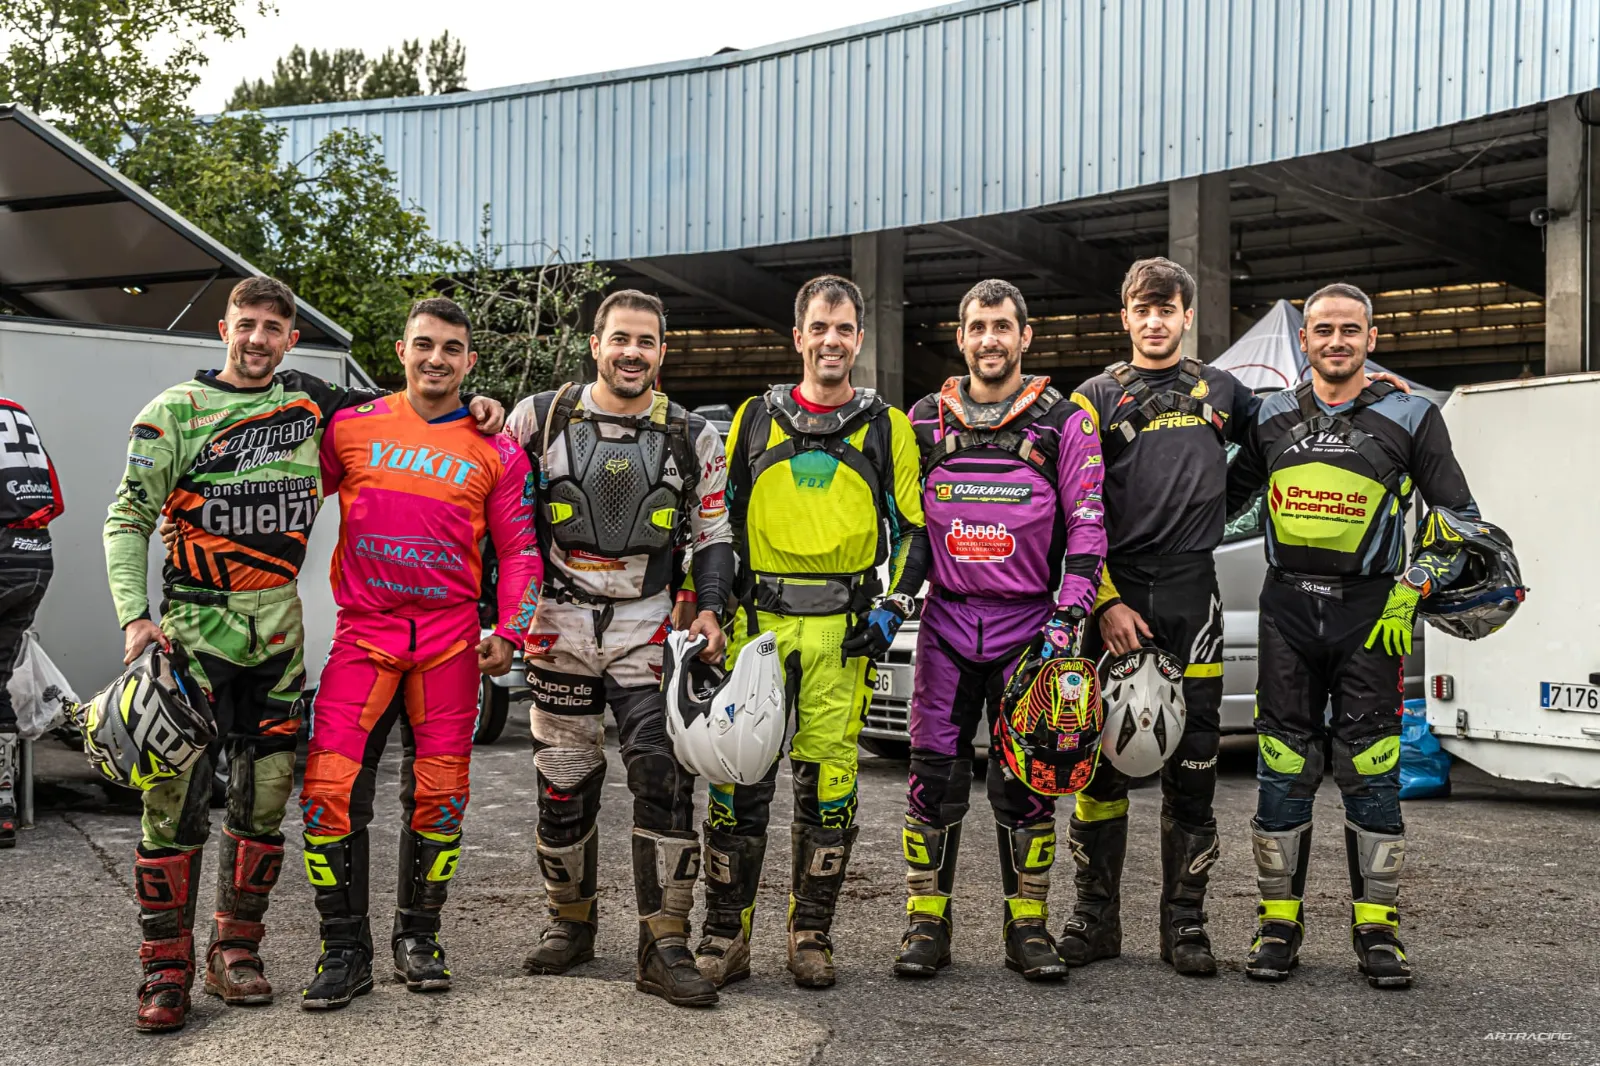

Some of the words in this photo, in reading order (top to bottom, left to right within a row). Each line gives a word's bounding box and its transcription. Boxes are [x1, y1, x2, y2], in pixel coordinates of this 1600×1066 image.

[203, 476, 317, 498] construcciones
[798, 477, 825, 489] FOX
[953, 483, 1030, 497] OJGRAPHICS
[1287, 486, 1343, 502] Grupo
[1346, 492, 1368, 504] de
[1285, 498, 1366, 518] Incendios
[526, 671, 570, 693] Grupo
[573, 684, 593, 696] de
[1551, 686, 1598, 709] 7176
